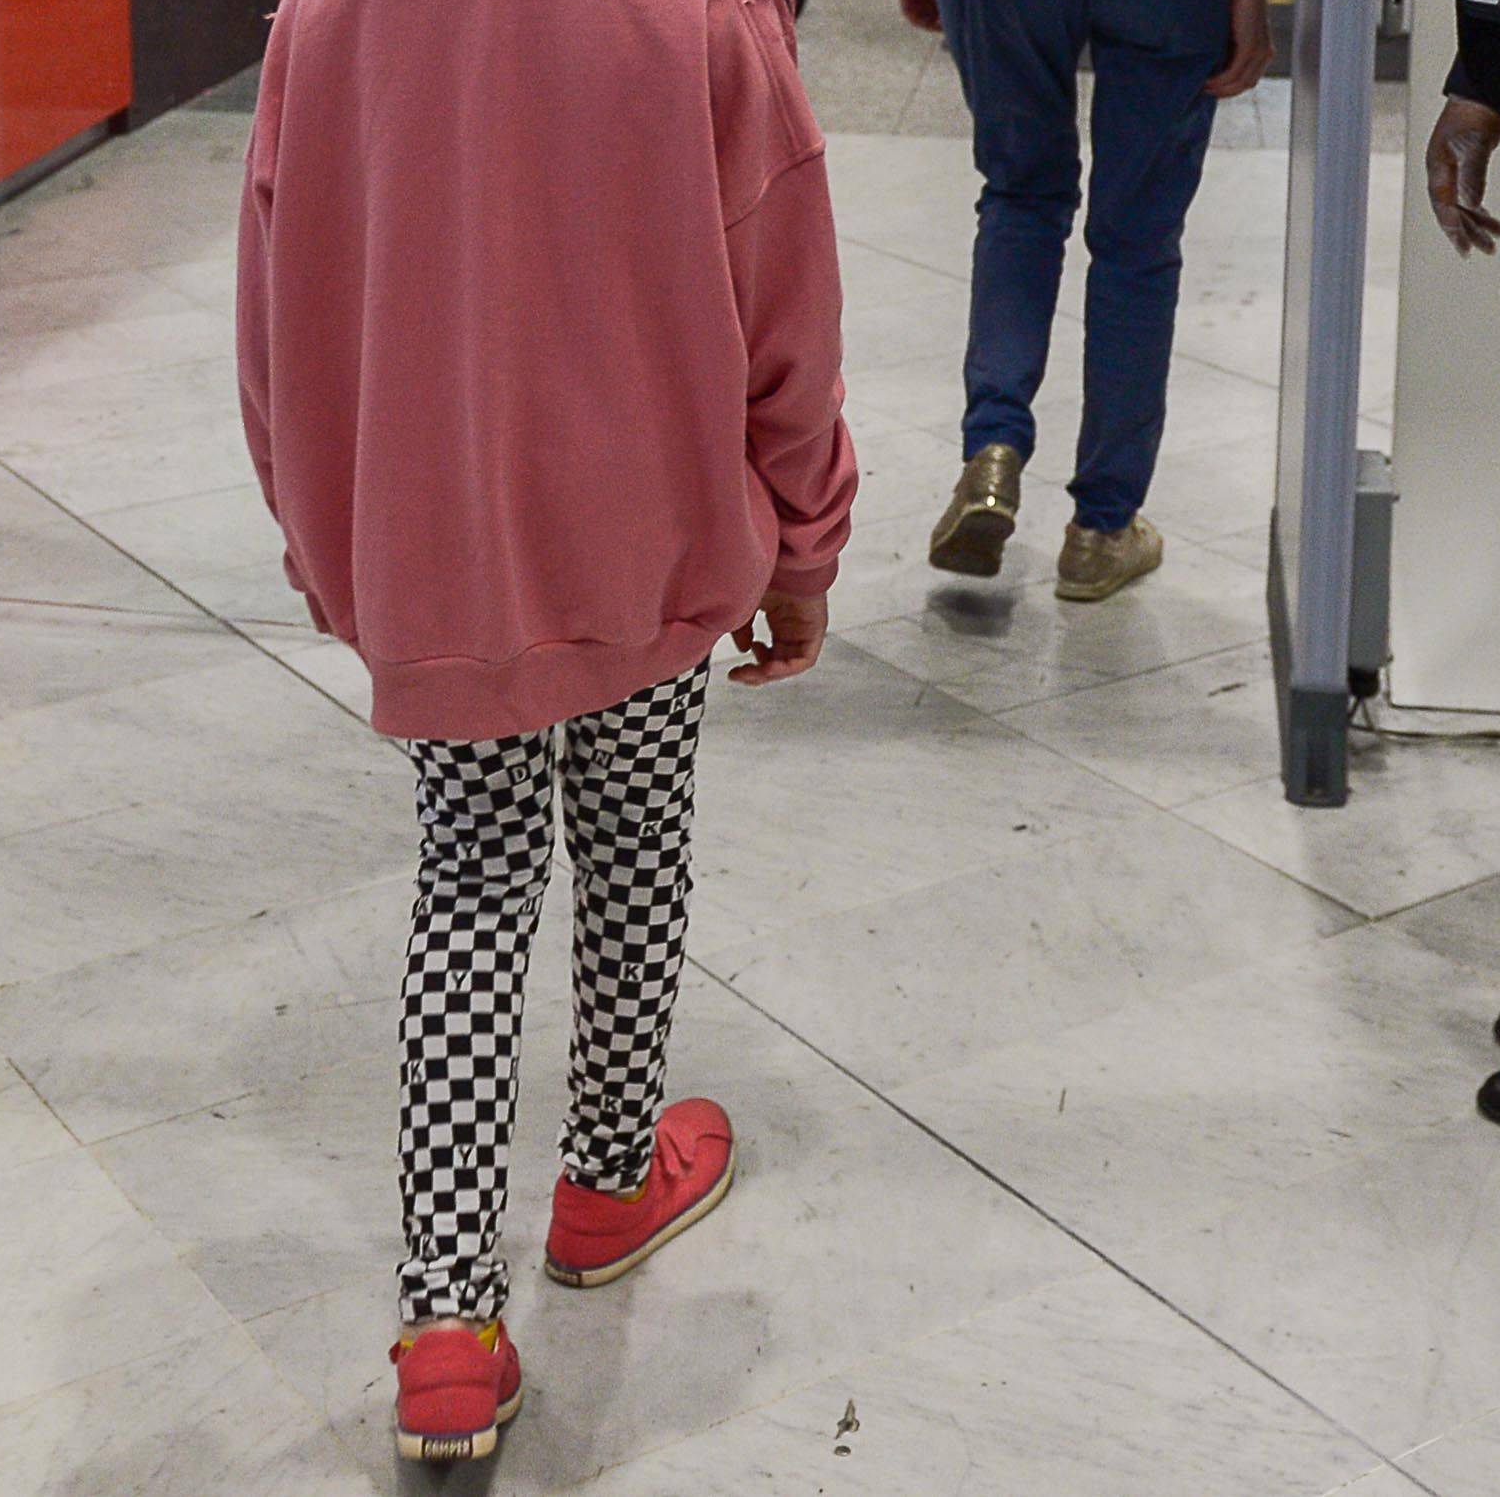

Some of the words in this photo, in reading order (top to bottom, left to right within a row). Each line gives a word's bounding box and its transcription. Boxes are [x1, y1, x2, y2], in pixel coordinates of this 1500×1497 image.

[674, 695, 687, 710] K
[512, 766, 528, 783] D
[643, 822, 659, 836] K
[461, 842, 477, 859] Y
[451, 970, 468, 991] Y
[623, 964, 640, 982] K
[655, 1028, 666, 1044] Y
[410, 1059, 423, 1083] K
[604, 1097, 619, 1112] K
[457, 1145, 473, 1167] Y
